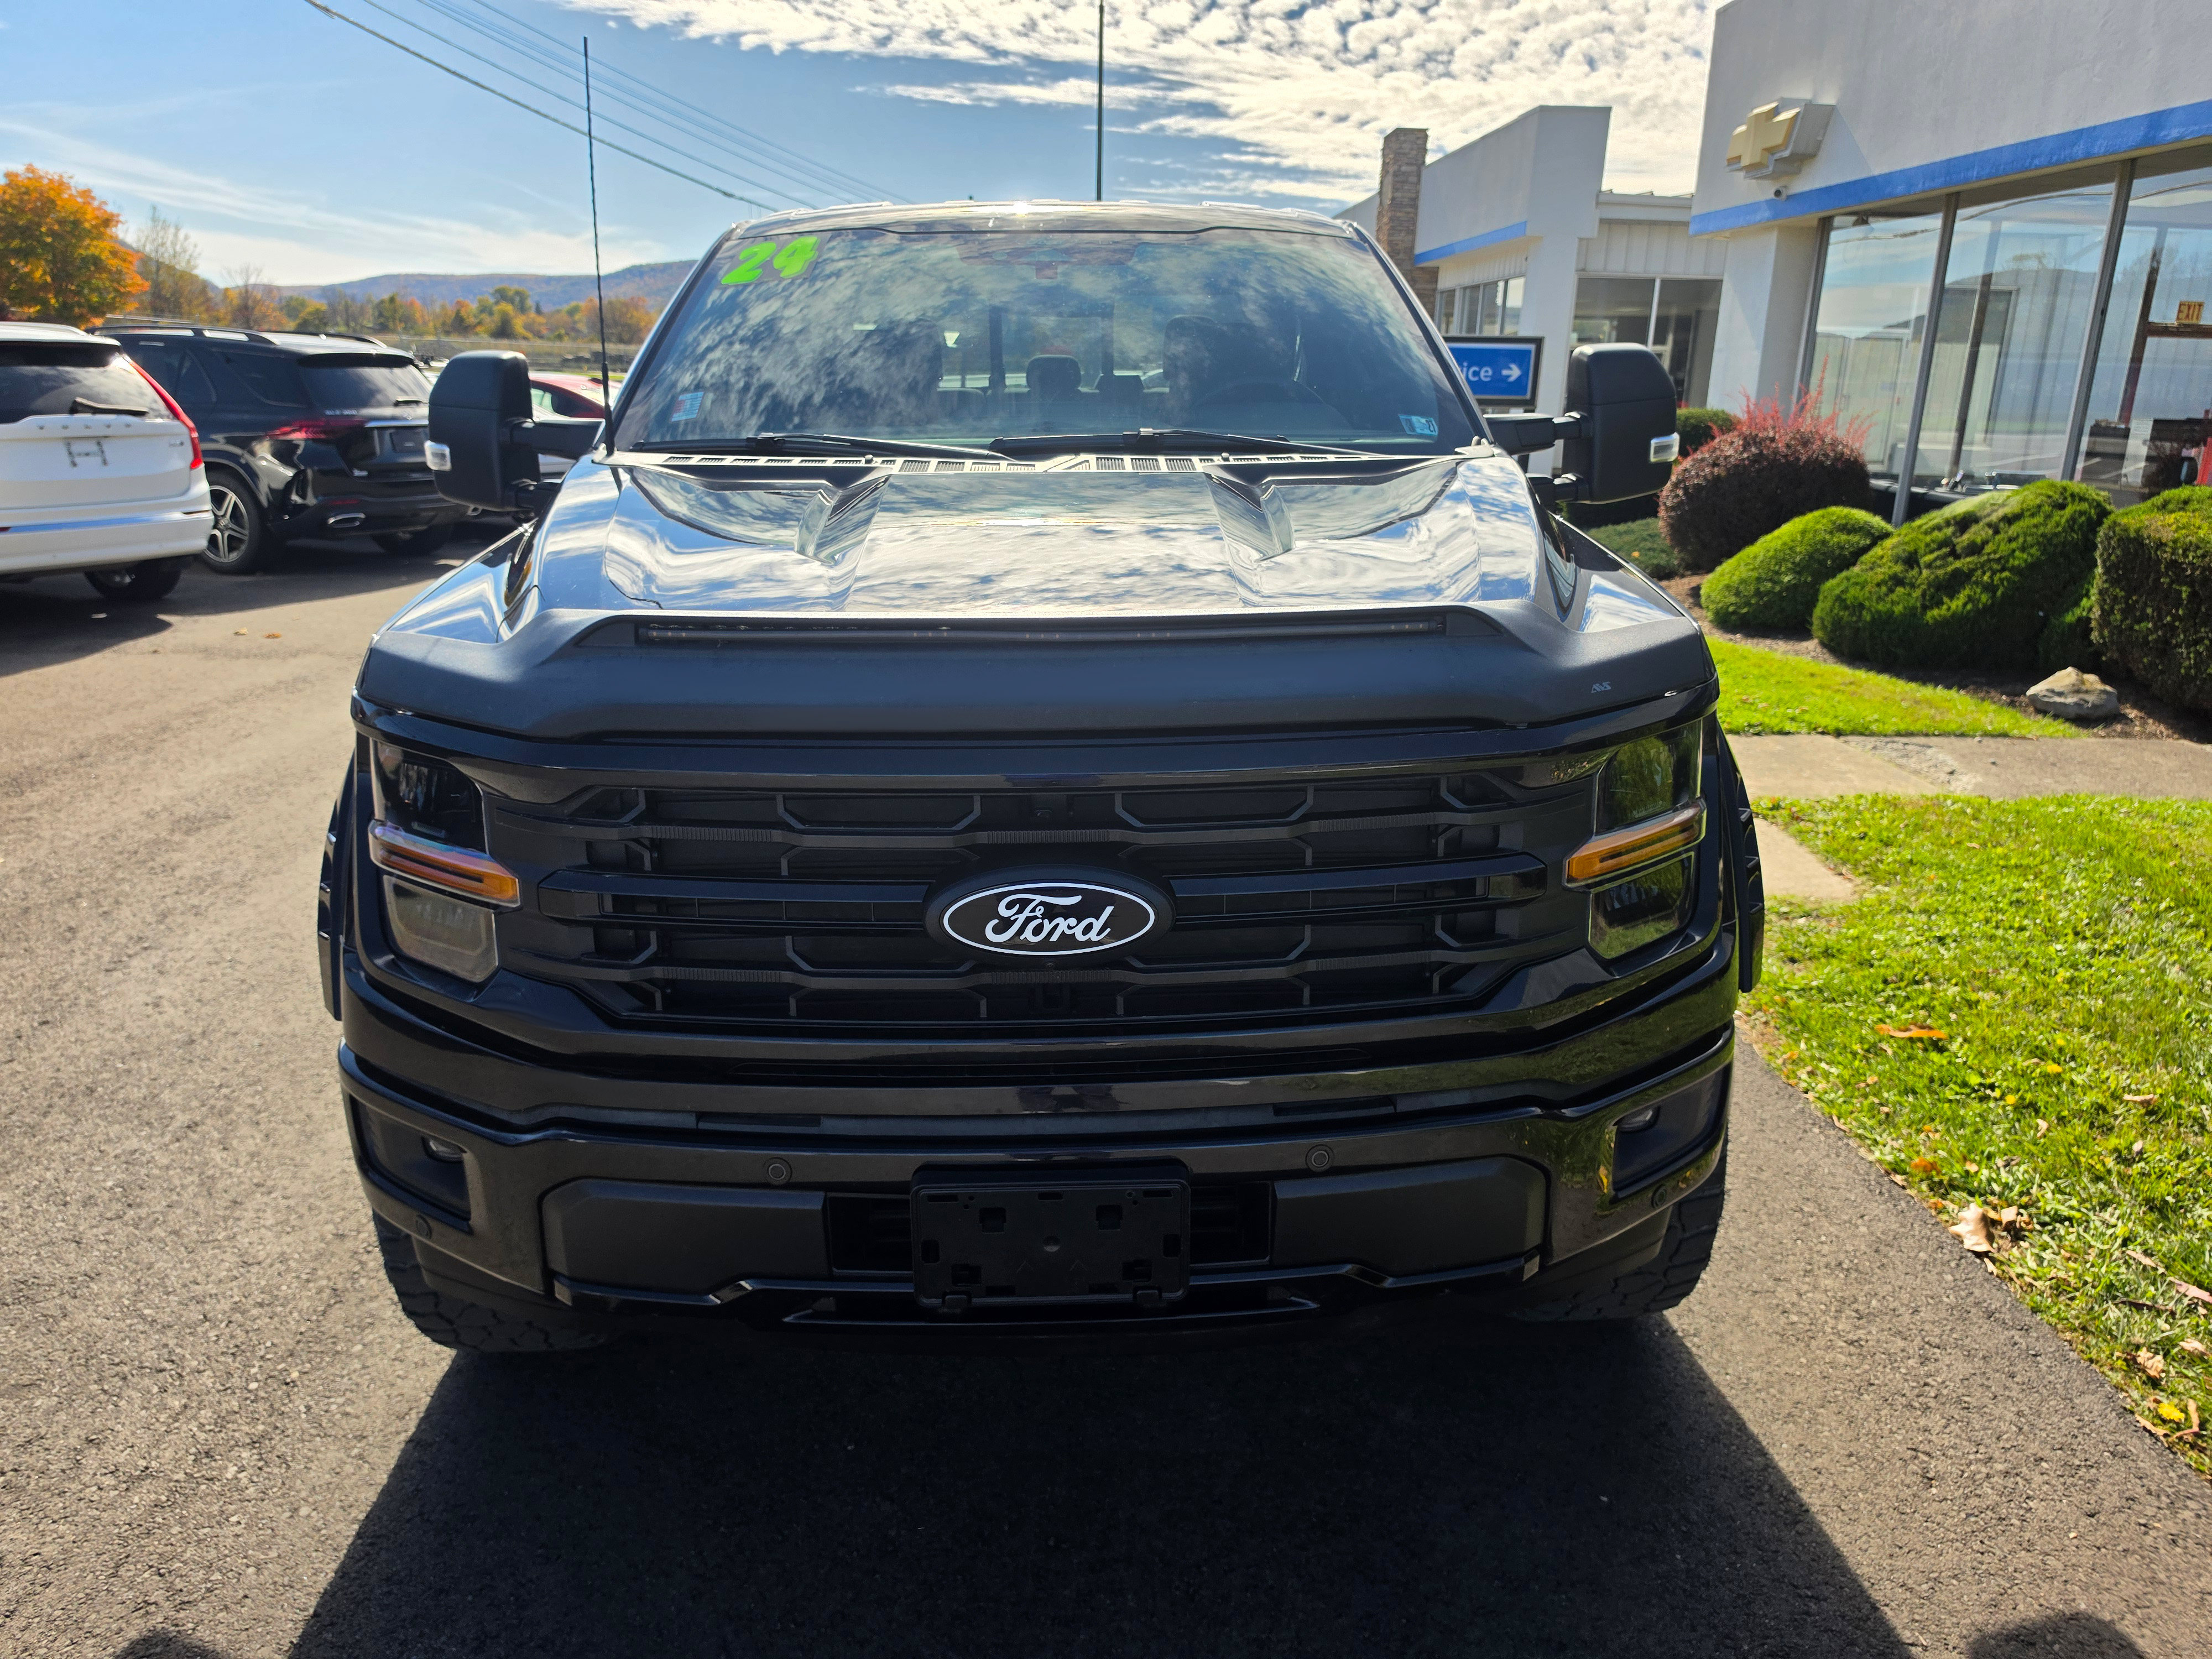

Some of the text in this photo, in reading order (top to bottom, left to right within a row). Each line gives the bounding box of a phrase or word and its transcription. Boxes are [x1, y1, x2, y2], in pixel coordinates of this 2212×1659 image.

[721, 236, 818, 285] 24
[2176, 303, 2204, 321] EXIT
[1460, 362, 1492, 382] ice
[985, 894, 1114, 942] Ford
